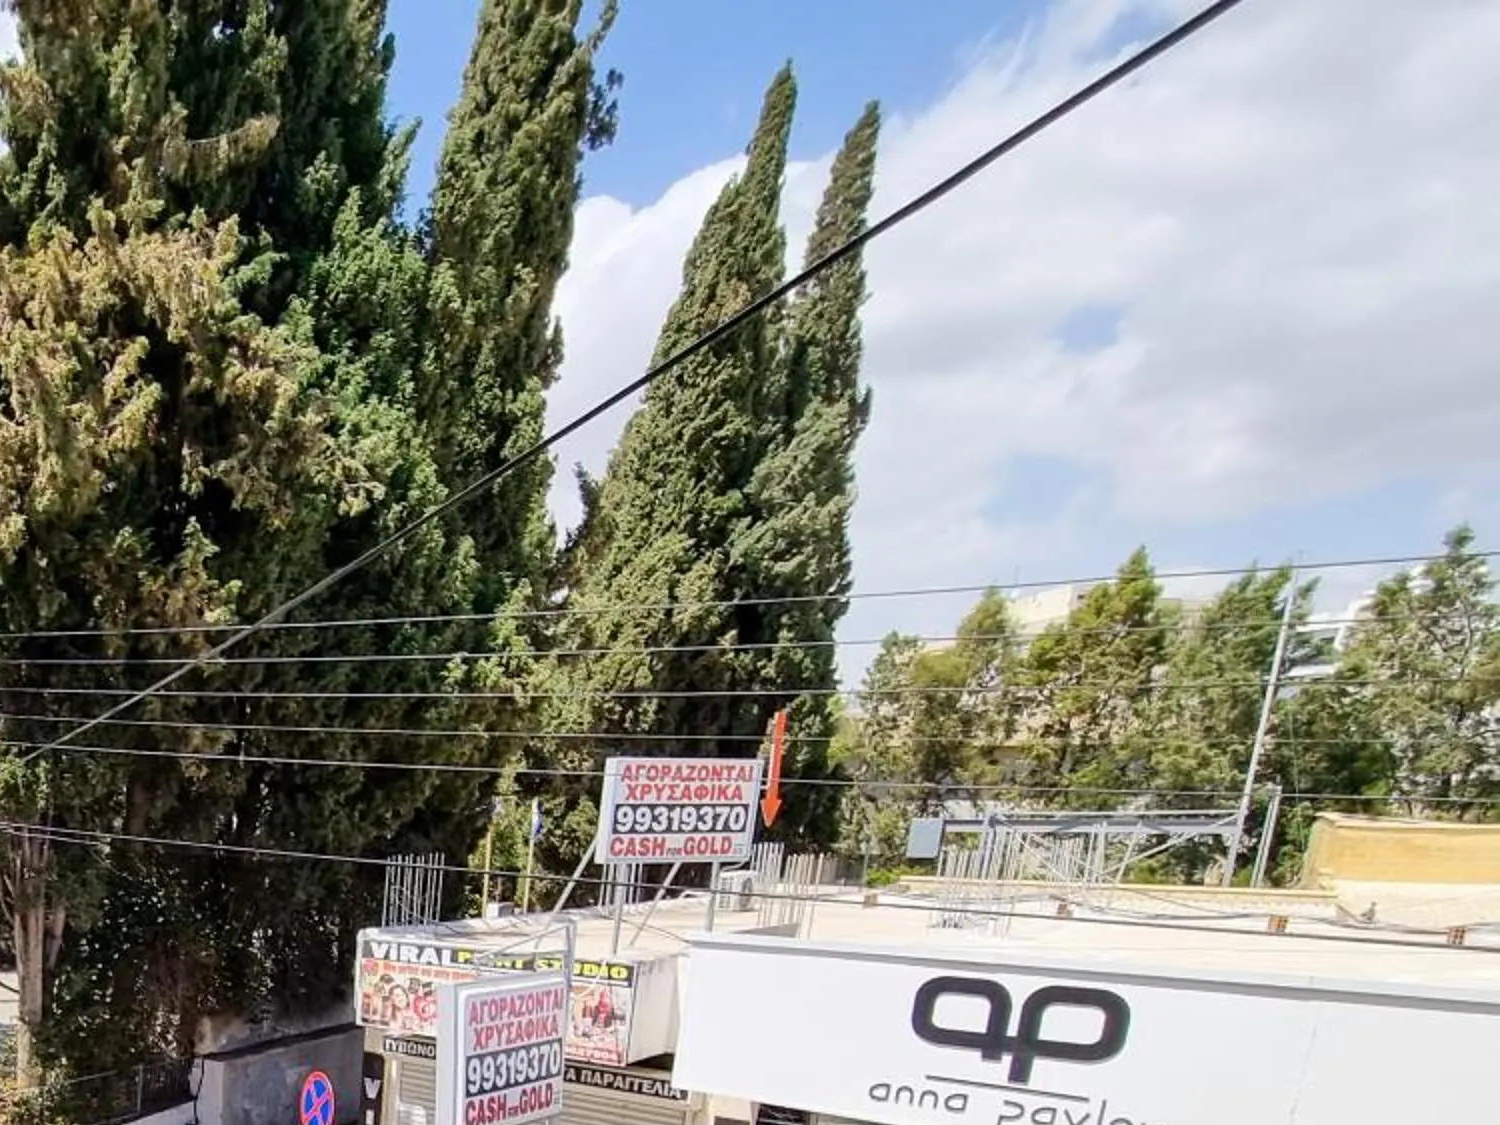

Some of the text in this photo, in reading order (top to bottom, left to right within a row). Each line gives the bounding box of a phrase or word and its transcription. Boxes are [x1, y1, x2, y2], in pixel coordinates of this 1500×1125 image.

[622, 764, 754, 783] ΑΓΟΡΑΖΟΝΤΑΙ
[626, 784, 744, 801] ΧΡΥΣΑΦΙΚΑ
[615, 805, 748, 833] 99319370
[610, 836, 667, 857] CASH
[683, 836, 733, 855] GOLD
[469, 987, 564, 1026] ΑΓΟΡΑΖΟΝΤΑΙ
[473, 1013, 558, 1051] ΧΡΥΣΑΦΙΚΑ
[467, 1042, 561, 1094] 99319370
[519, 1082, 553, 1114] GOLD
[868, 1082, 969, 1114] anna
